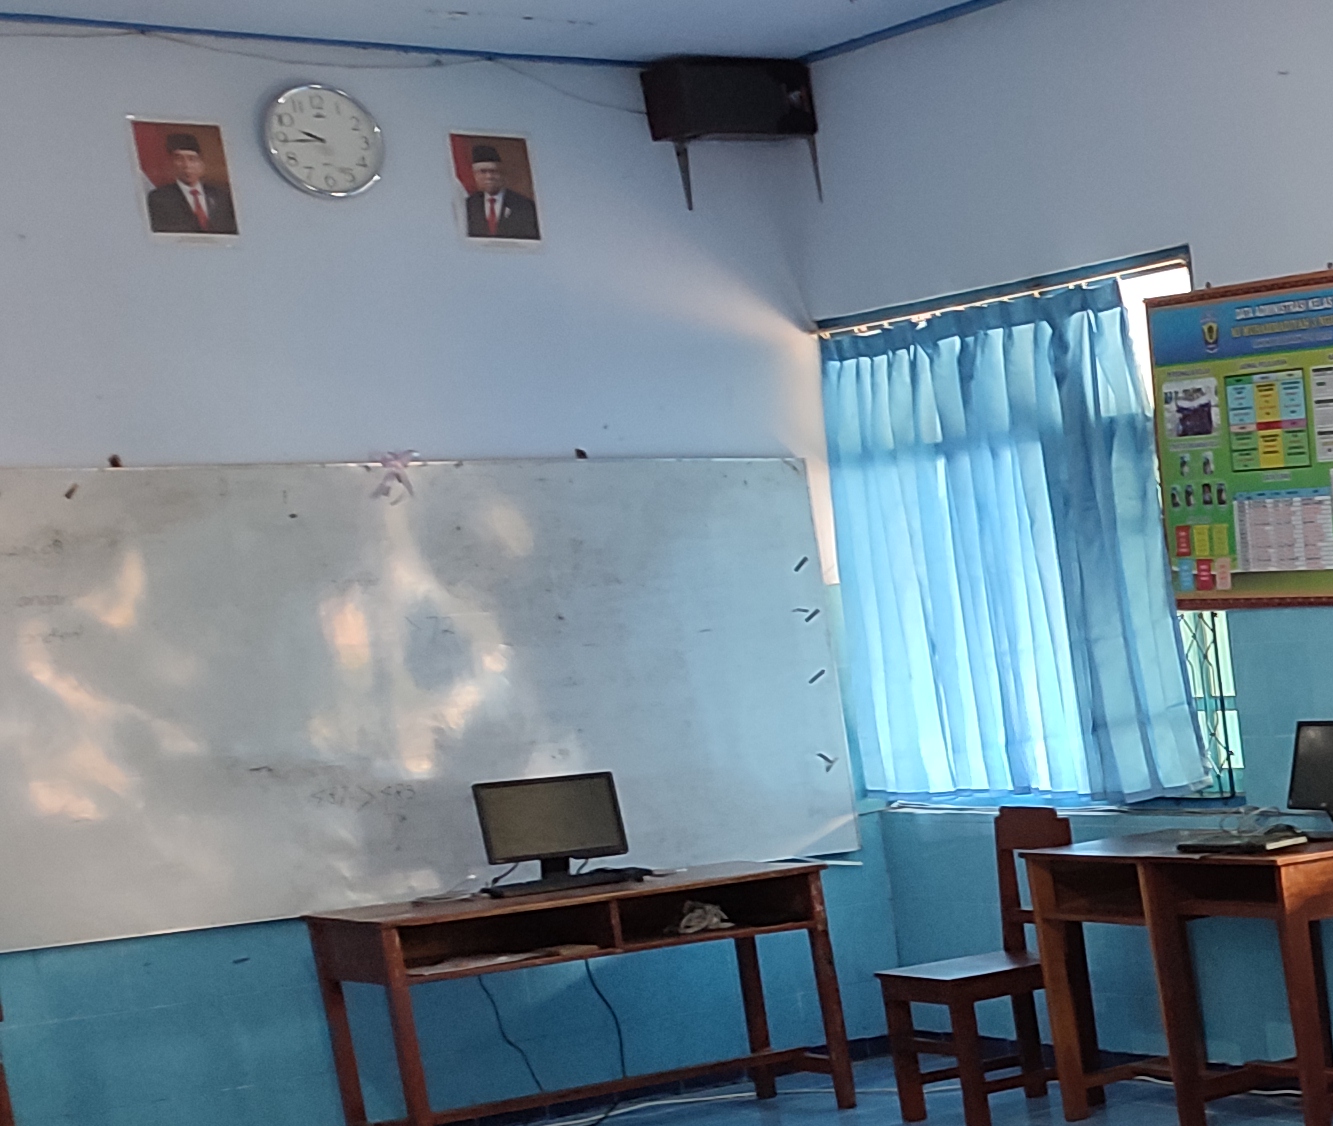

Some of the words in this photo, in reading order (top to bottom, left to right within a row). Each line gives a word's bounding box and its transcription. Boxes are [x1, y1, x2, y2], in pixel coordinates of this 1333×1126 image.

[290, 97, 304, 113] 11
[308, 94, 324, 110] 12
[334, 100, 341, 115] 1
[277, 113, 294, 127] 10
[350, 115, 360, 131] 2
[275, 131, 289, 143] 9
[361, 136, 370, 151] 3
[285, 151, 299, 167] 8
[355, 156, 368, 168] 4
[303, 165, 315, 181] 7
[338, 167, 356, 183] 5
[324, 175, 336, 188] 6
[1308, 295, 1333, 310] KELAS
